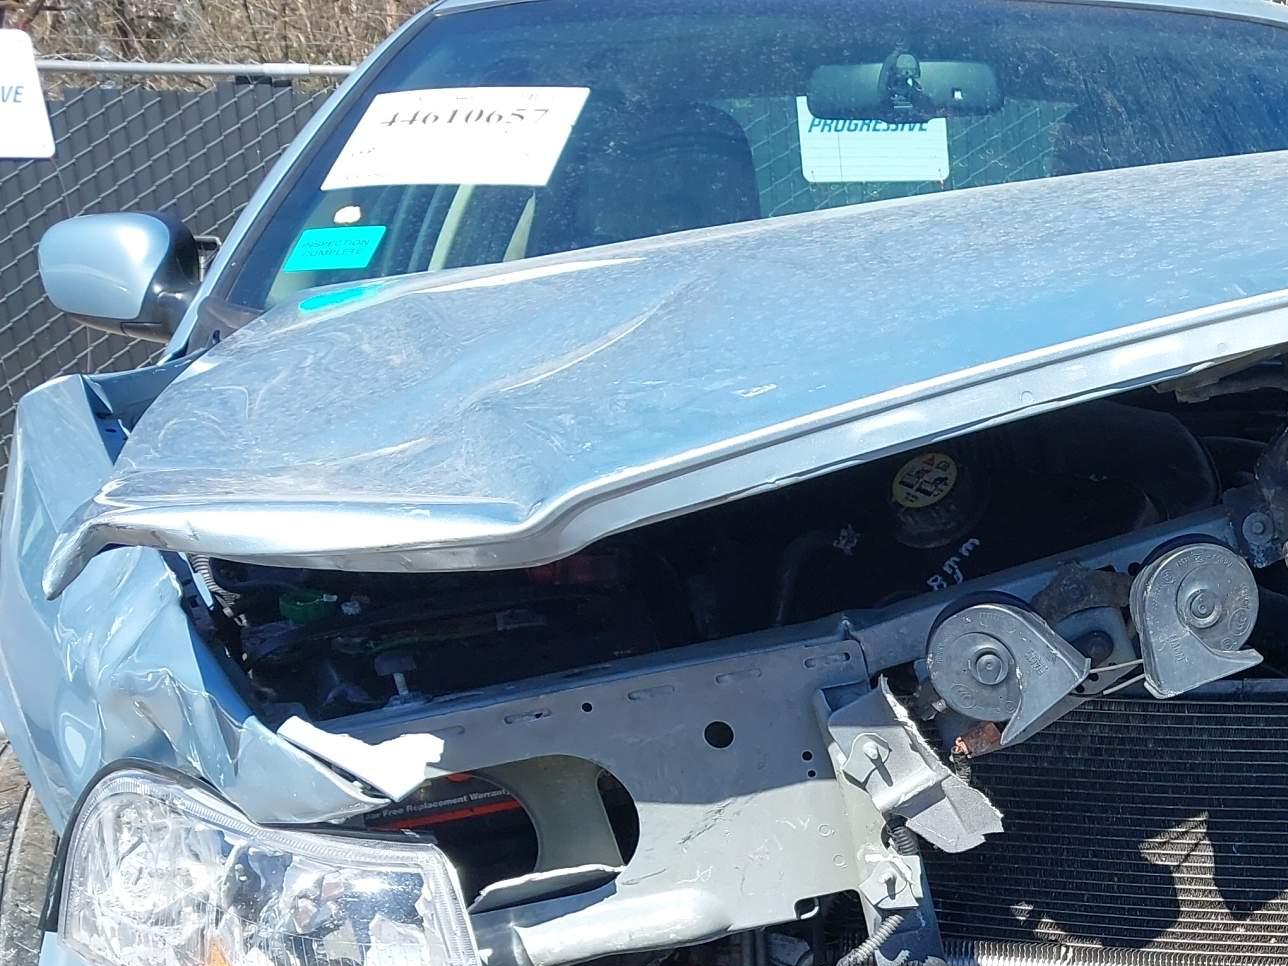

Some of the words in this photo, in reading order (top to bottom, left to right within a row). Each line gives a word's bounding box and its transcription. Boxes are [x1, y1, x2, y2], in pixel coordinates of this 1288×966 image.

[380, 108, 550, 127] 44610657
[301, 239, 370, 249] INSPECTION
[382, 807, 404, 818] Free
[406, 795, 468, 813] Replacement
